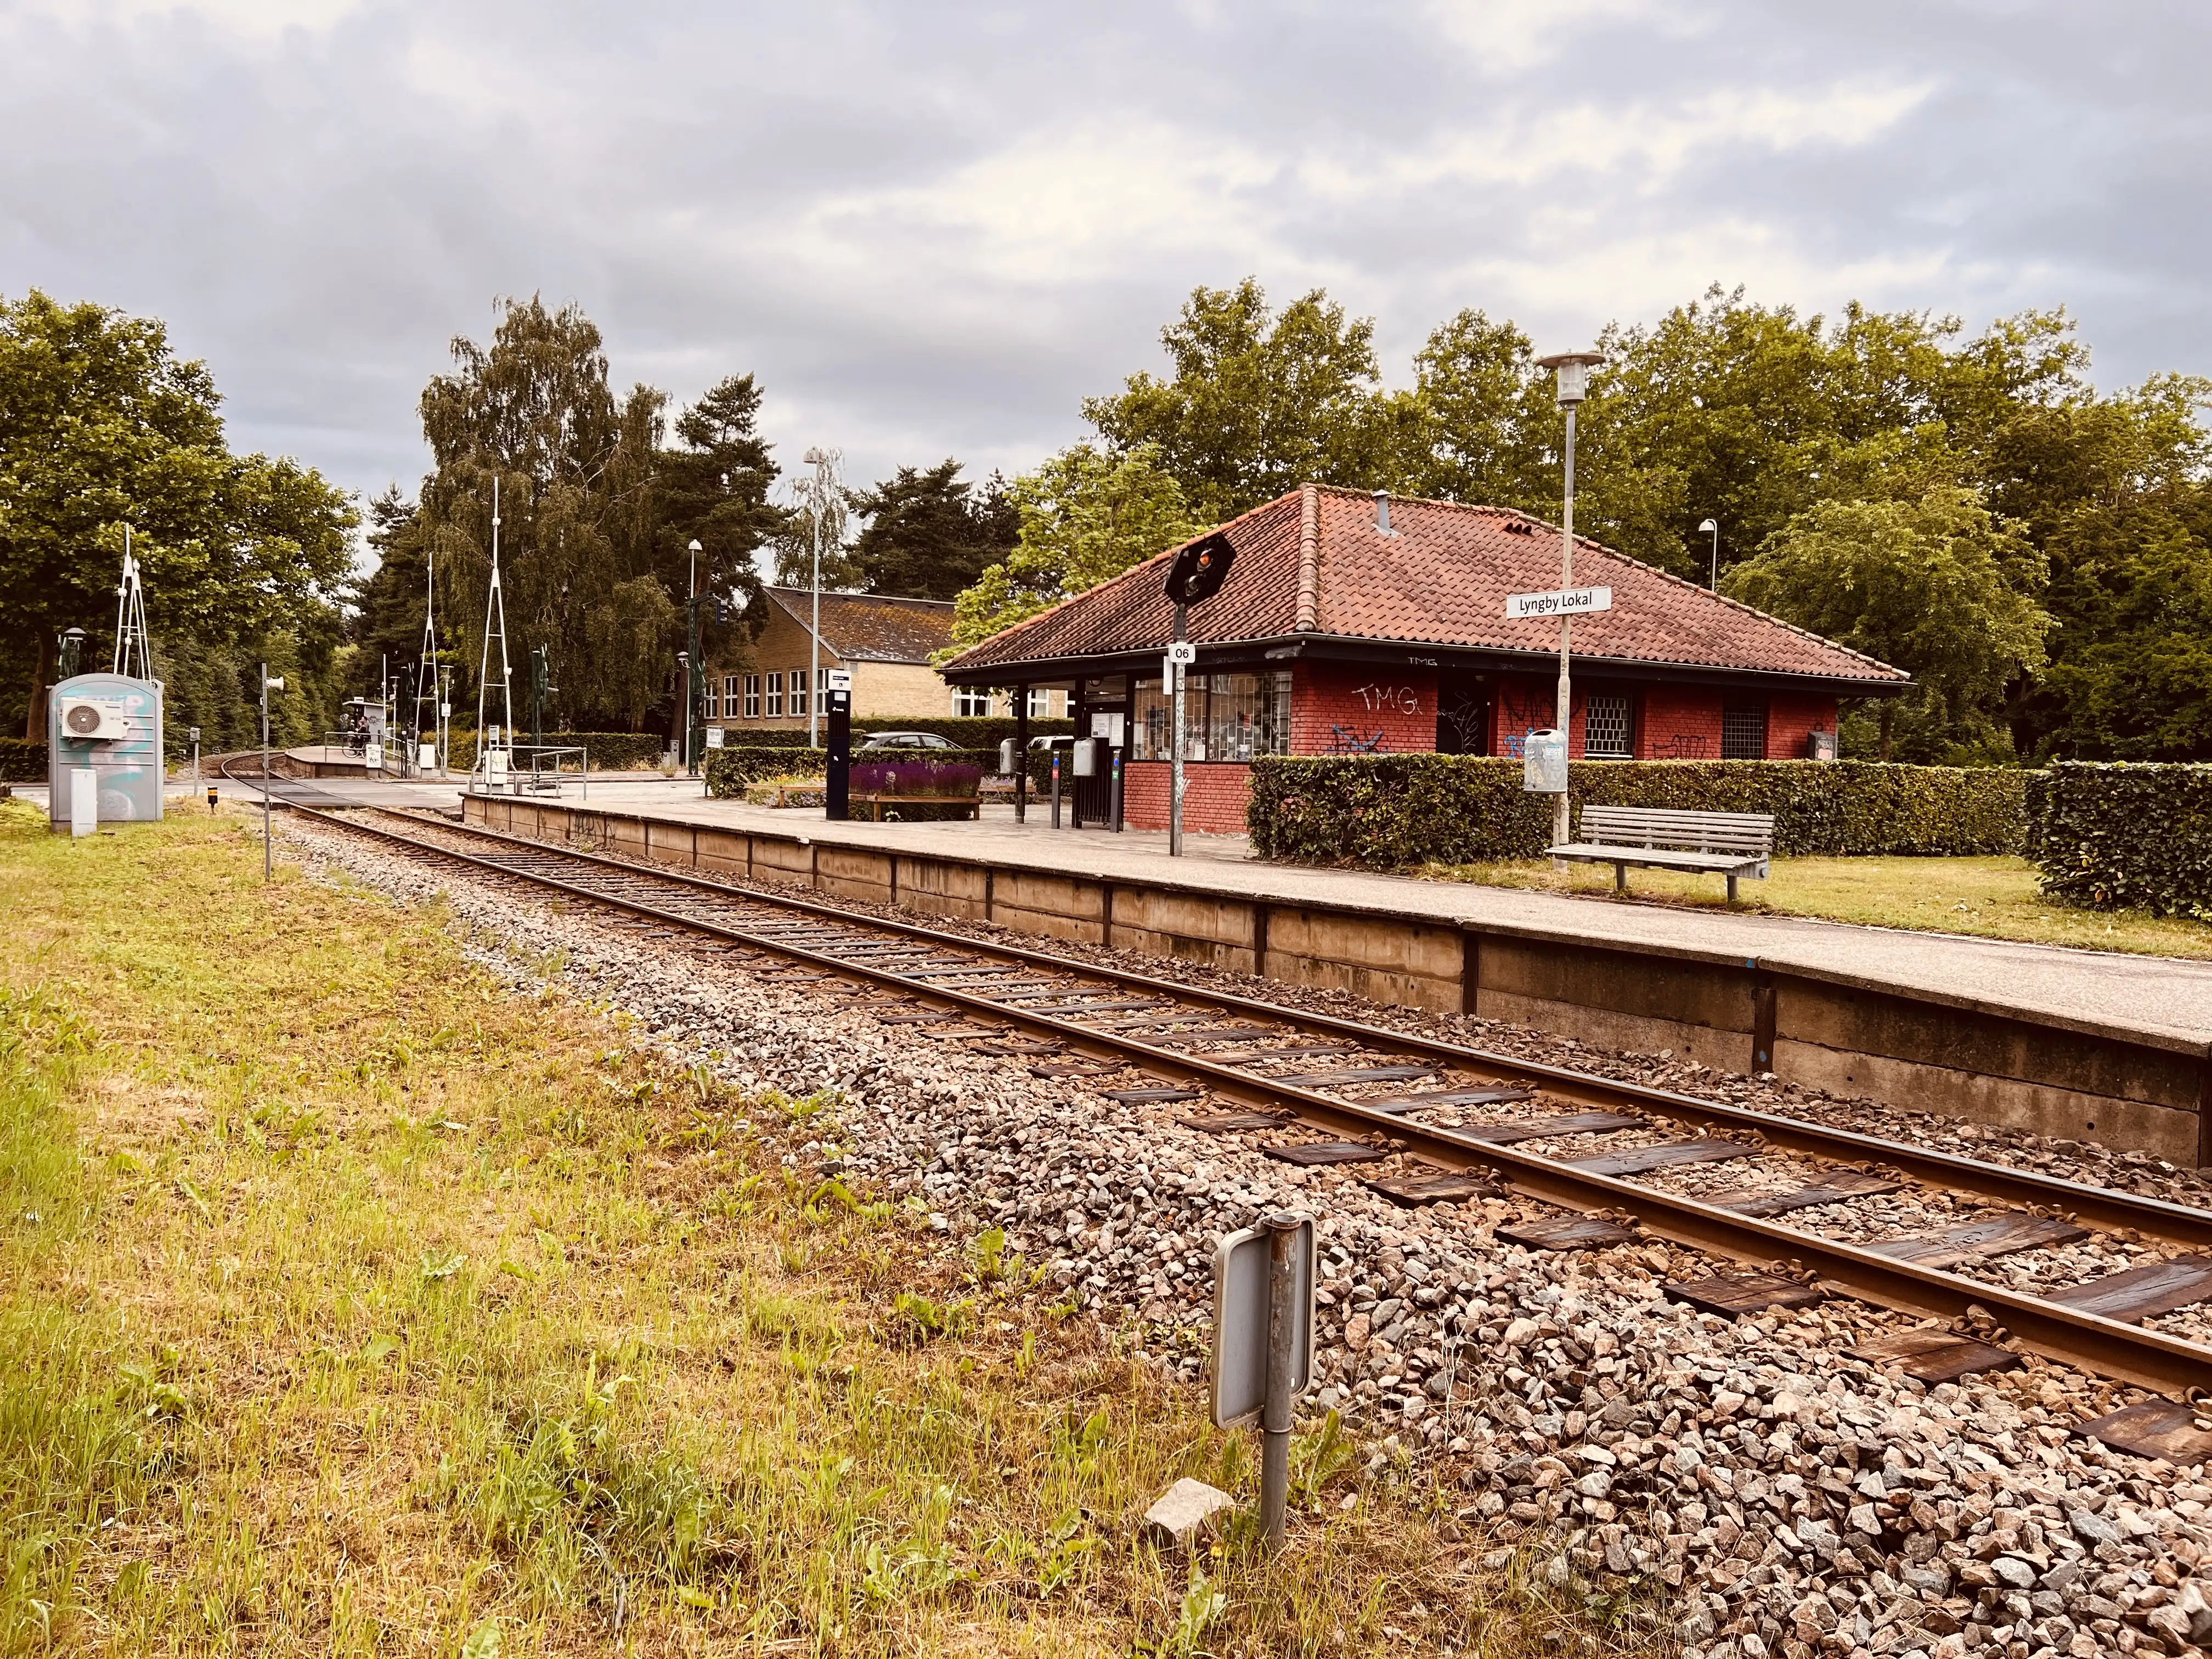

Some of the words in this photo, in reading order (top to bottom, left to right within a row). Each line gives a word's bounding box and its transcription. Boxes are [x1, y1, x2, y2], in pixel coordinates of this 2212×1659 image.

[1520, 595, 1559, 614] Lyngby
[1562, 591, 1592, 607] Lokal
[1176, 648, 1189, 658] 06
[1408, 657, 1438, 666] TMG
[1351, 683, 1423, 715] TMG
